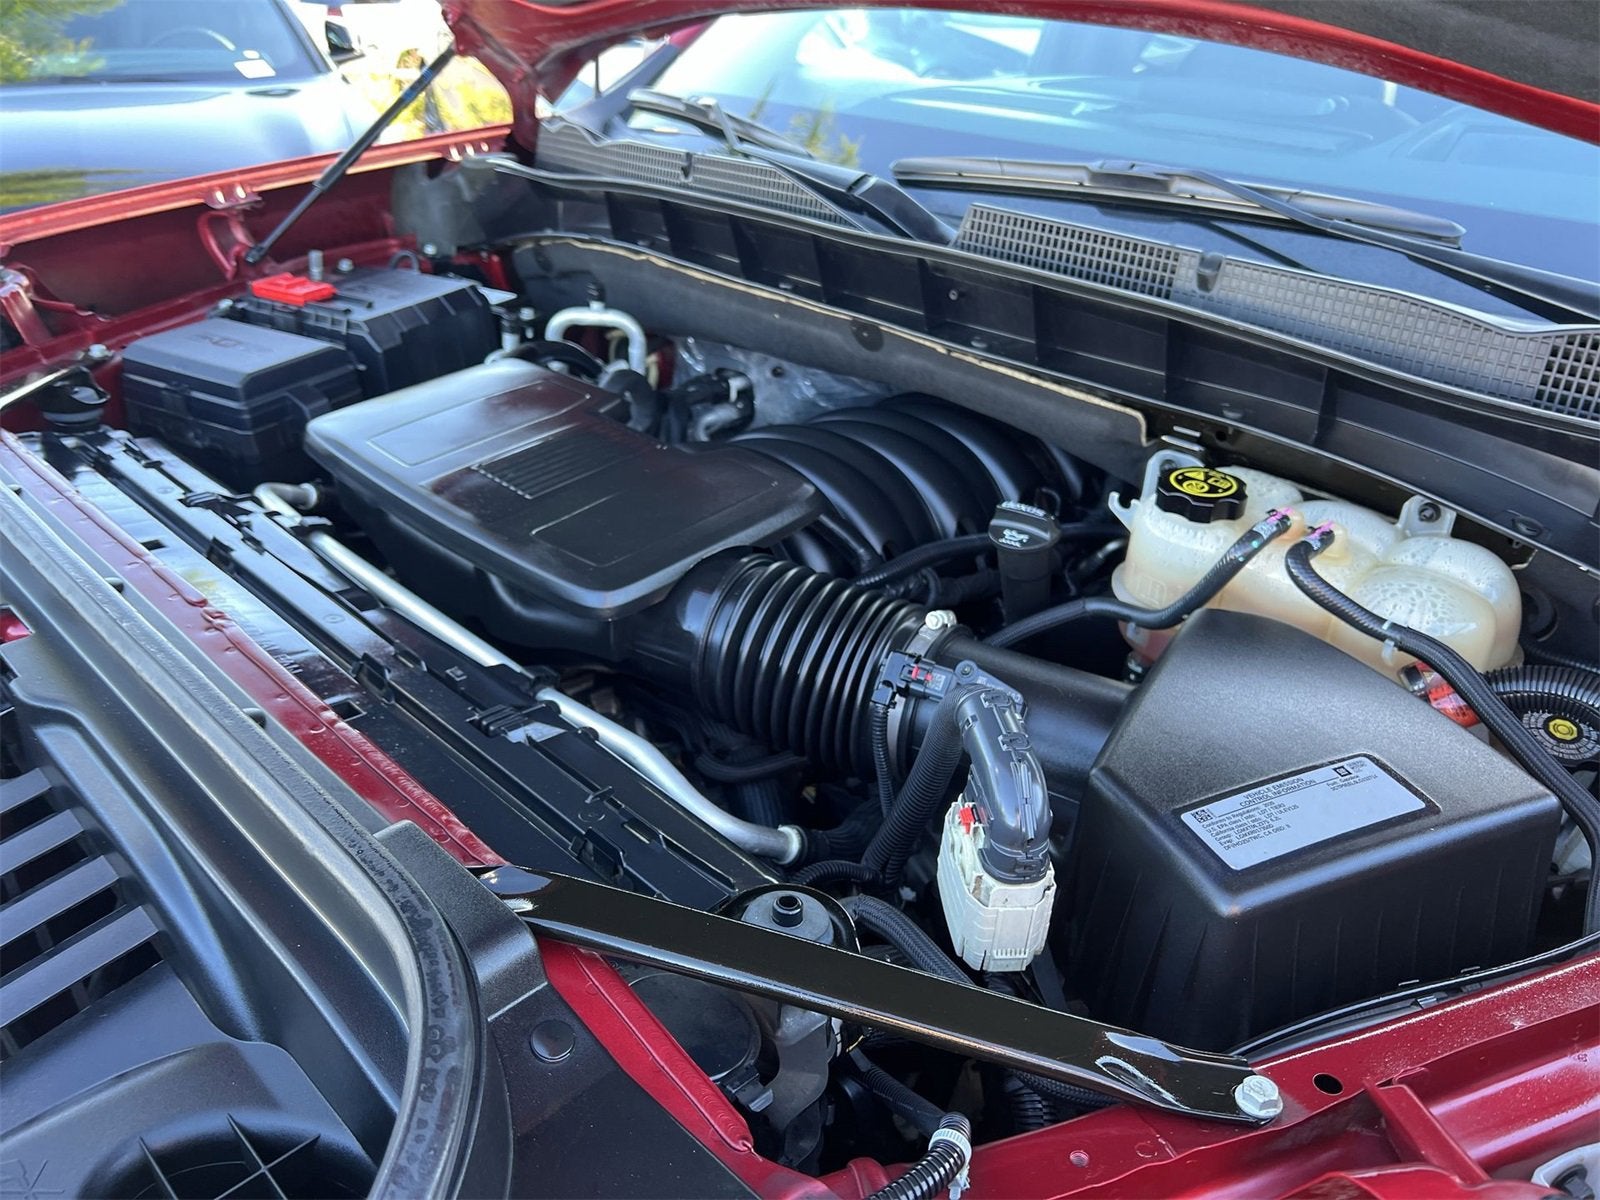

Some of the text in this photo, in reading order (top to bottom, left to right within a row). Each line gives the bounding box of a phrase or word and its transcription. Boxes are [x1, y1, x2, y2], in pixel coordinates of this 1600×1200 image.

[1240, 793, 1272, 807] CONTROL
[1271, 780, 1317, 796] INFORMATION
[1243, 778, 1305, 800] VEHICLE EMISSION
